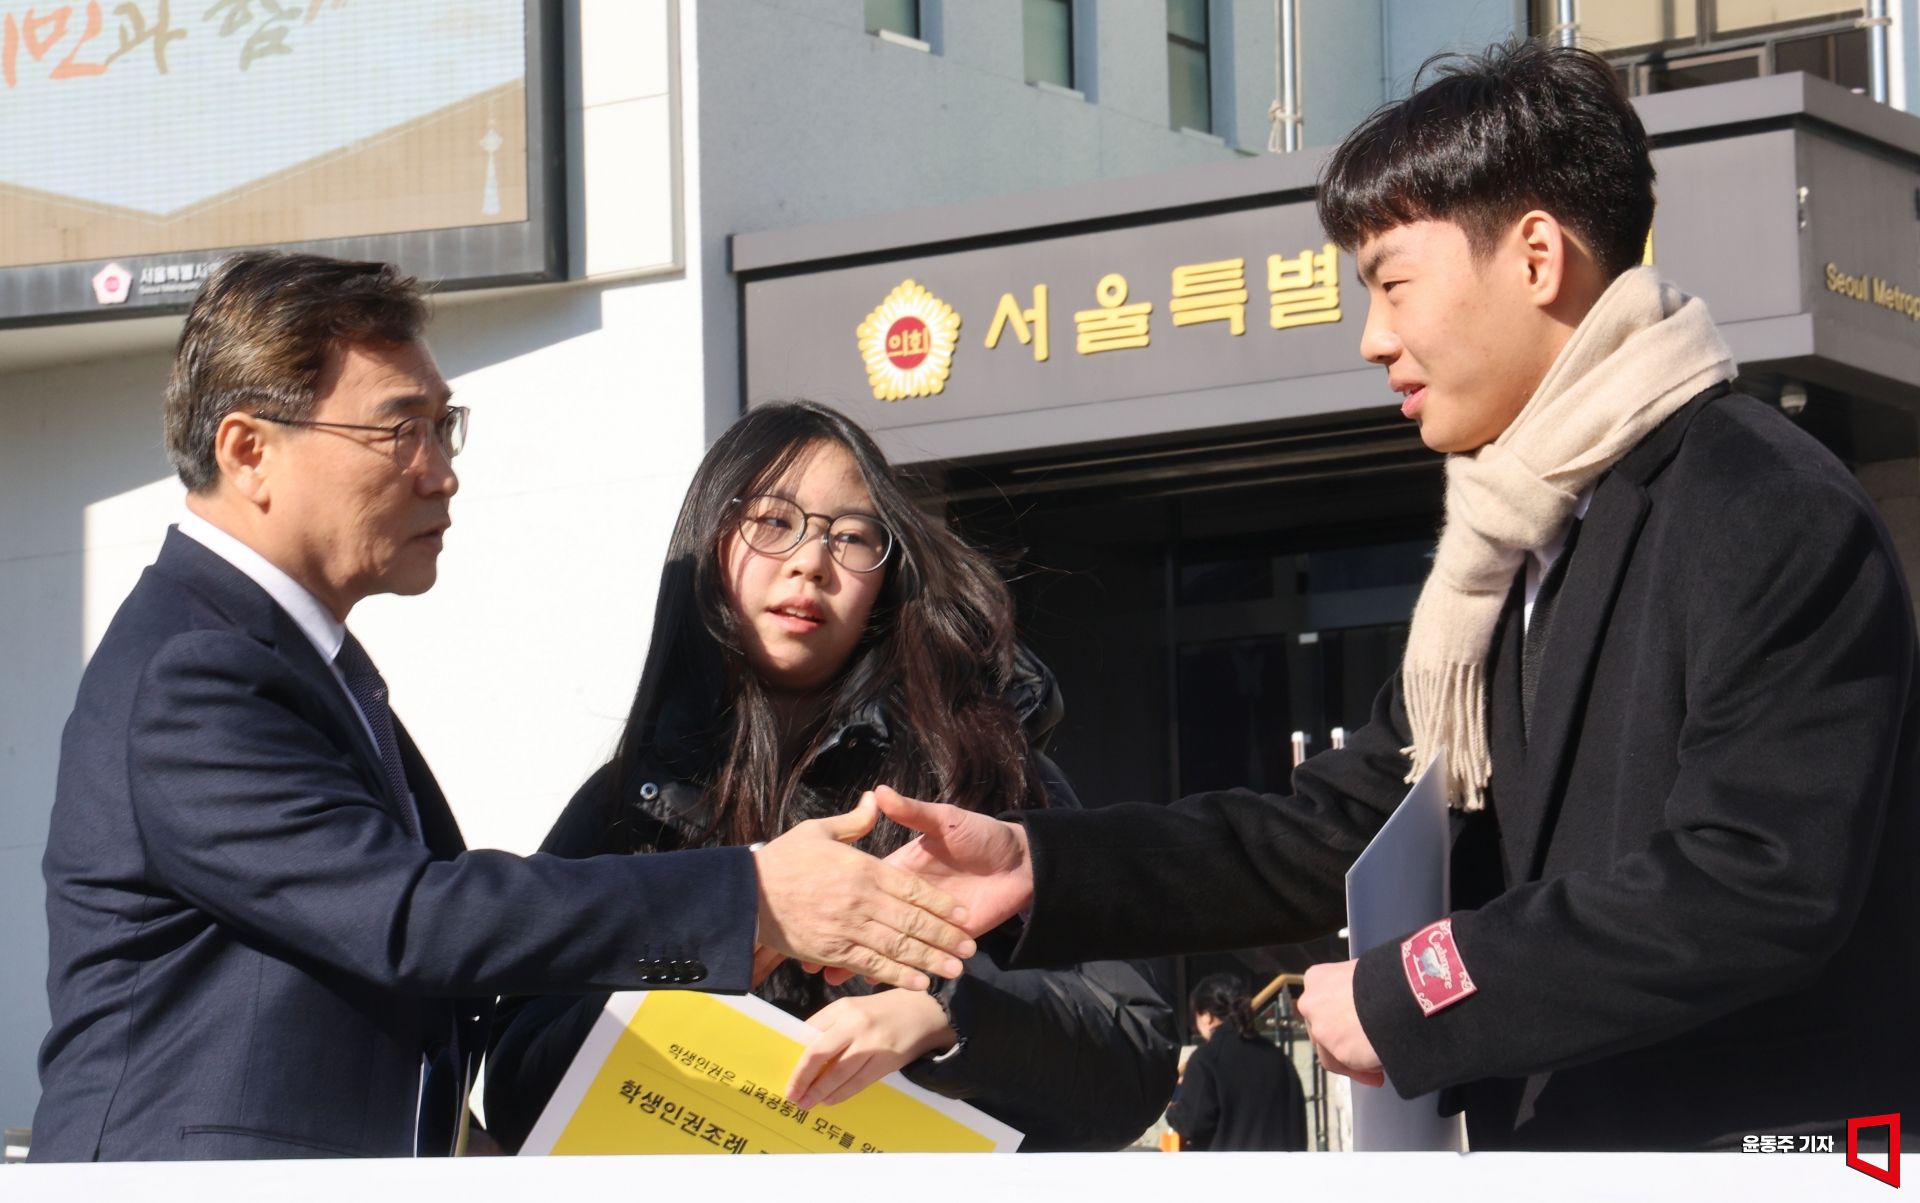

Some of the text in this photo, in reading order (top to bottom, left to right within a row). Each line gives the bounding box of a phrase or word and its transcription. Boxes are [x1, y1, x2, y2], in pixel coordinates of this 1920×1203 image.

[1825, 261, 1869, 301] Seoul
[887, 327, 929, 358] 의회
[619, 1079, 748, 1154] 학생인권조례
[668, 1043, 736, 1087] 학생인권은
[739, 1079, 809, 1125] 교육공동체
[811, 1117, 856, 1150] 모두를
